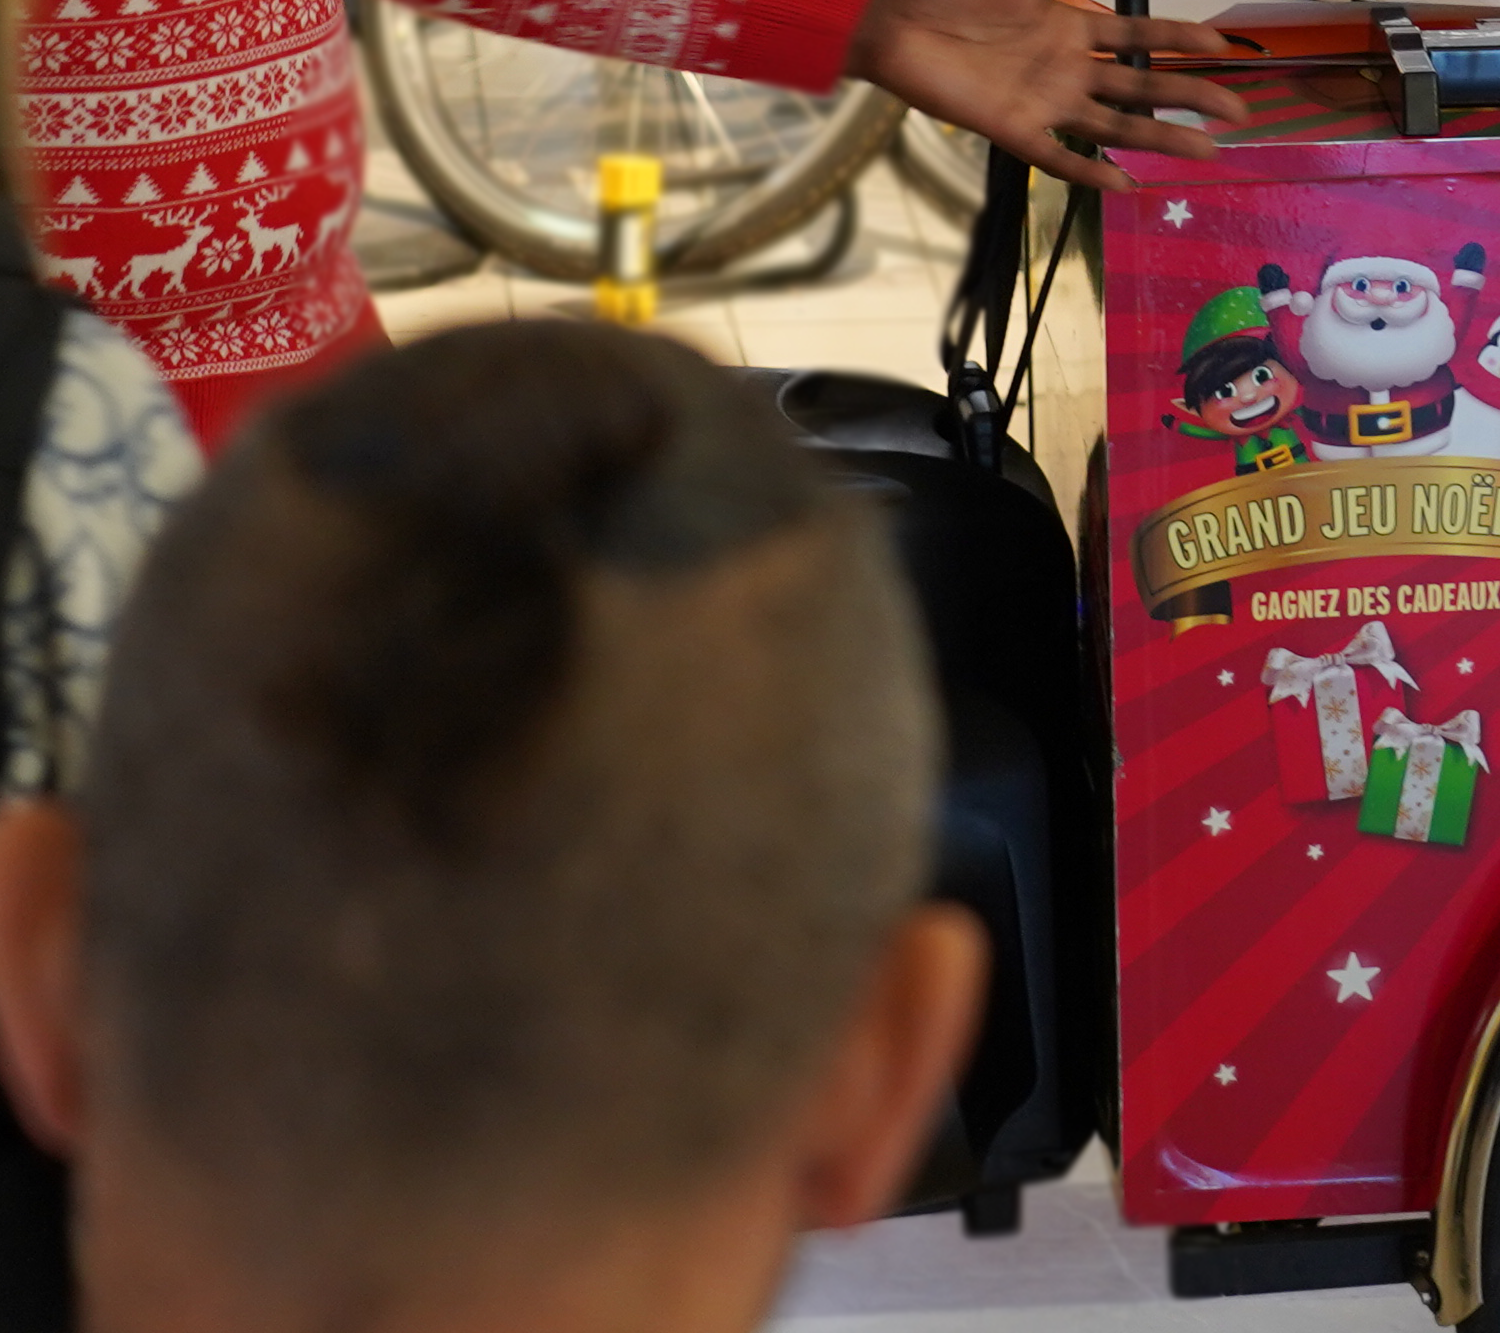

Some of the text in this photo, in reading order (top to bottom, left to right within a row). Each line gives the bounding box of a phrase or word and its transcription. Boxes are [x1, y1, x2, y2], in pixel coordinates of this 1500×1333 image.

[1166, 494, 1305, 570] GRAND
[1321, 484, 1397, 539] JEU
[1251, 589, 1339, 622] GAGNEZ
[1347, 586, 1391, 615] DES
[1399, 582, 1500, 613] CADEAUX
